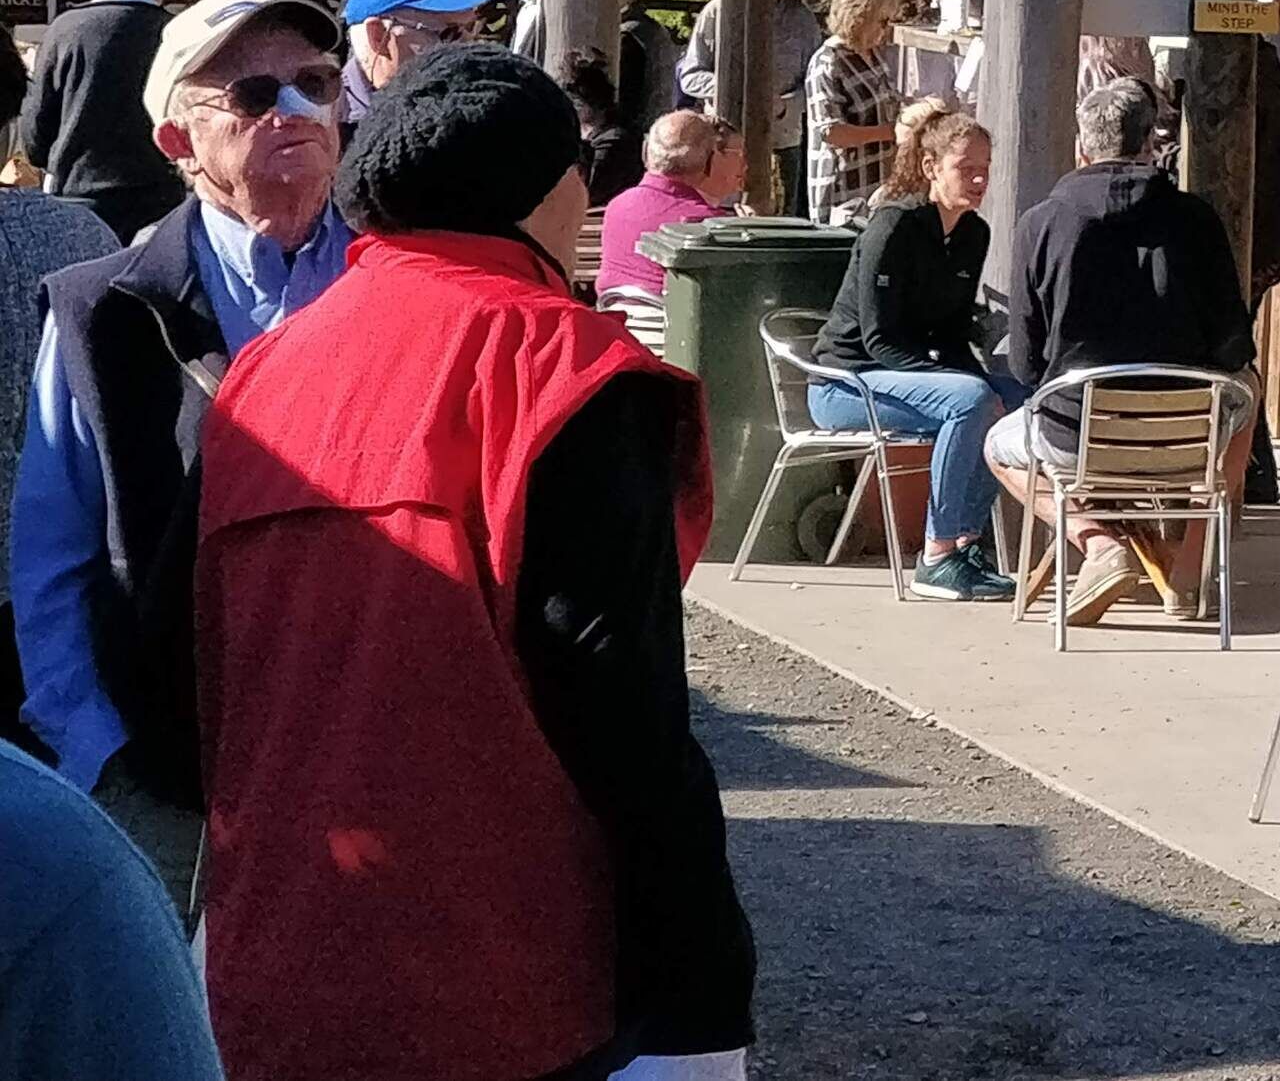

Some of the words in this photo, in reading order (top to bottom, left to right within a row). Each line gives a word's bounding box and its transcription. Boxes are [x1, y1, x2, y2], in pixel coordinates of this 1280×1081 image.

[1207, 1, 1240, 14] MIND
[1243, 2, 1269, 15] THE
[1221, 17, 1255, 29] STEP
